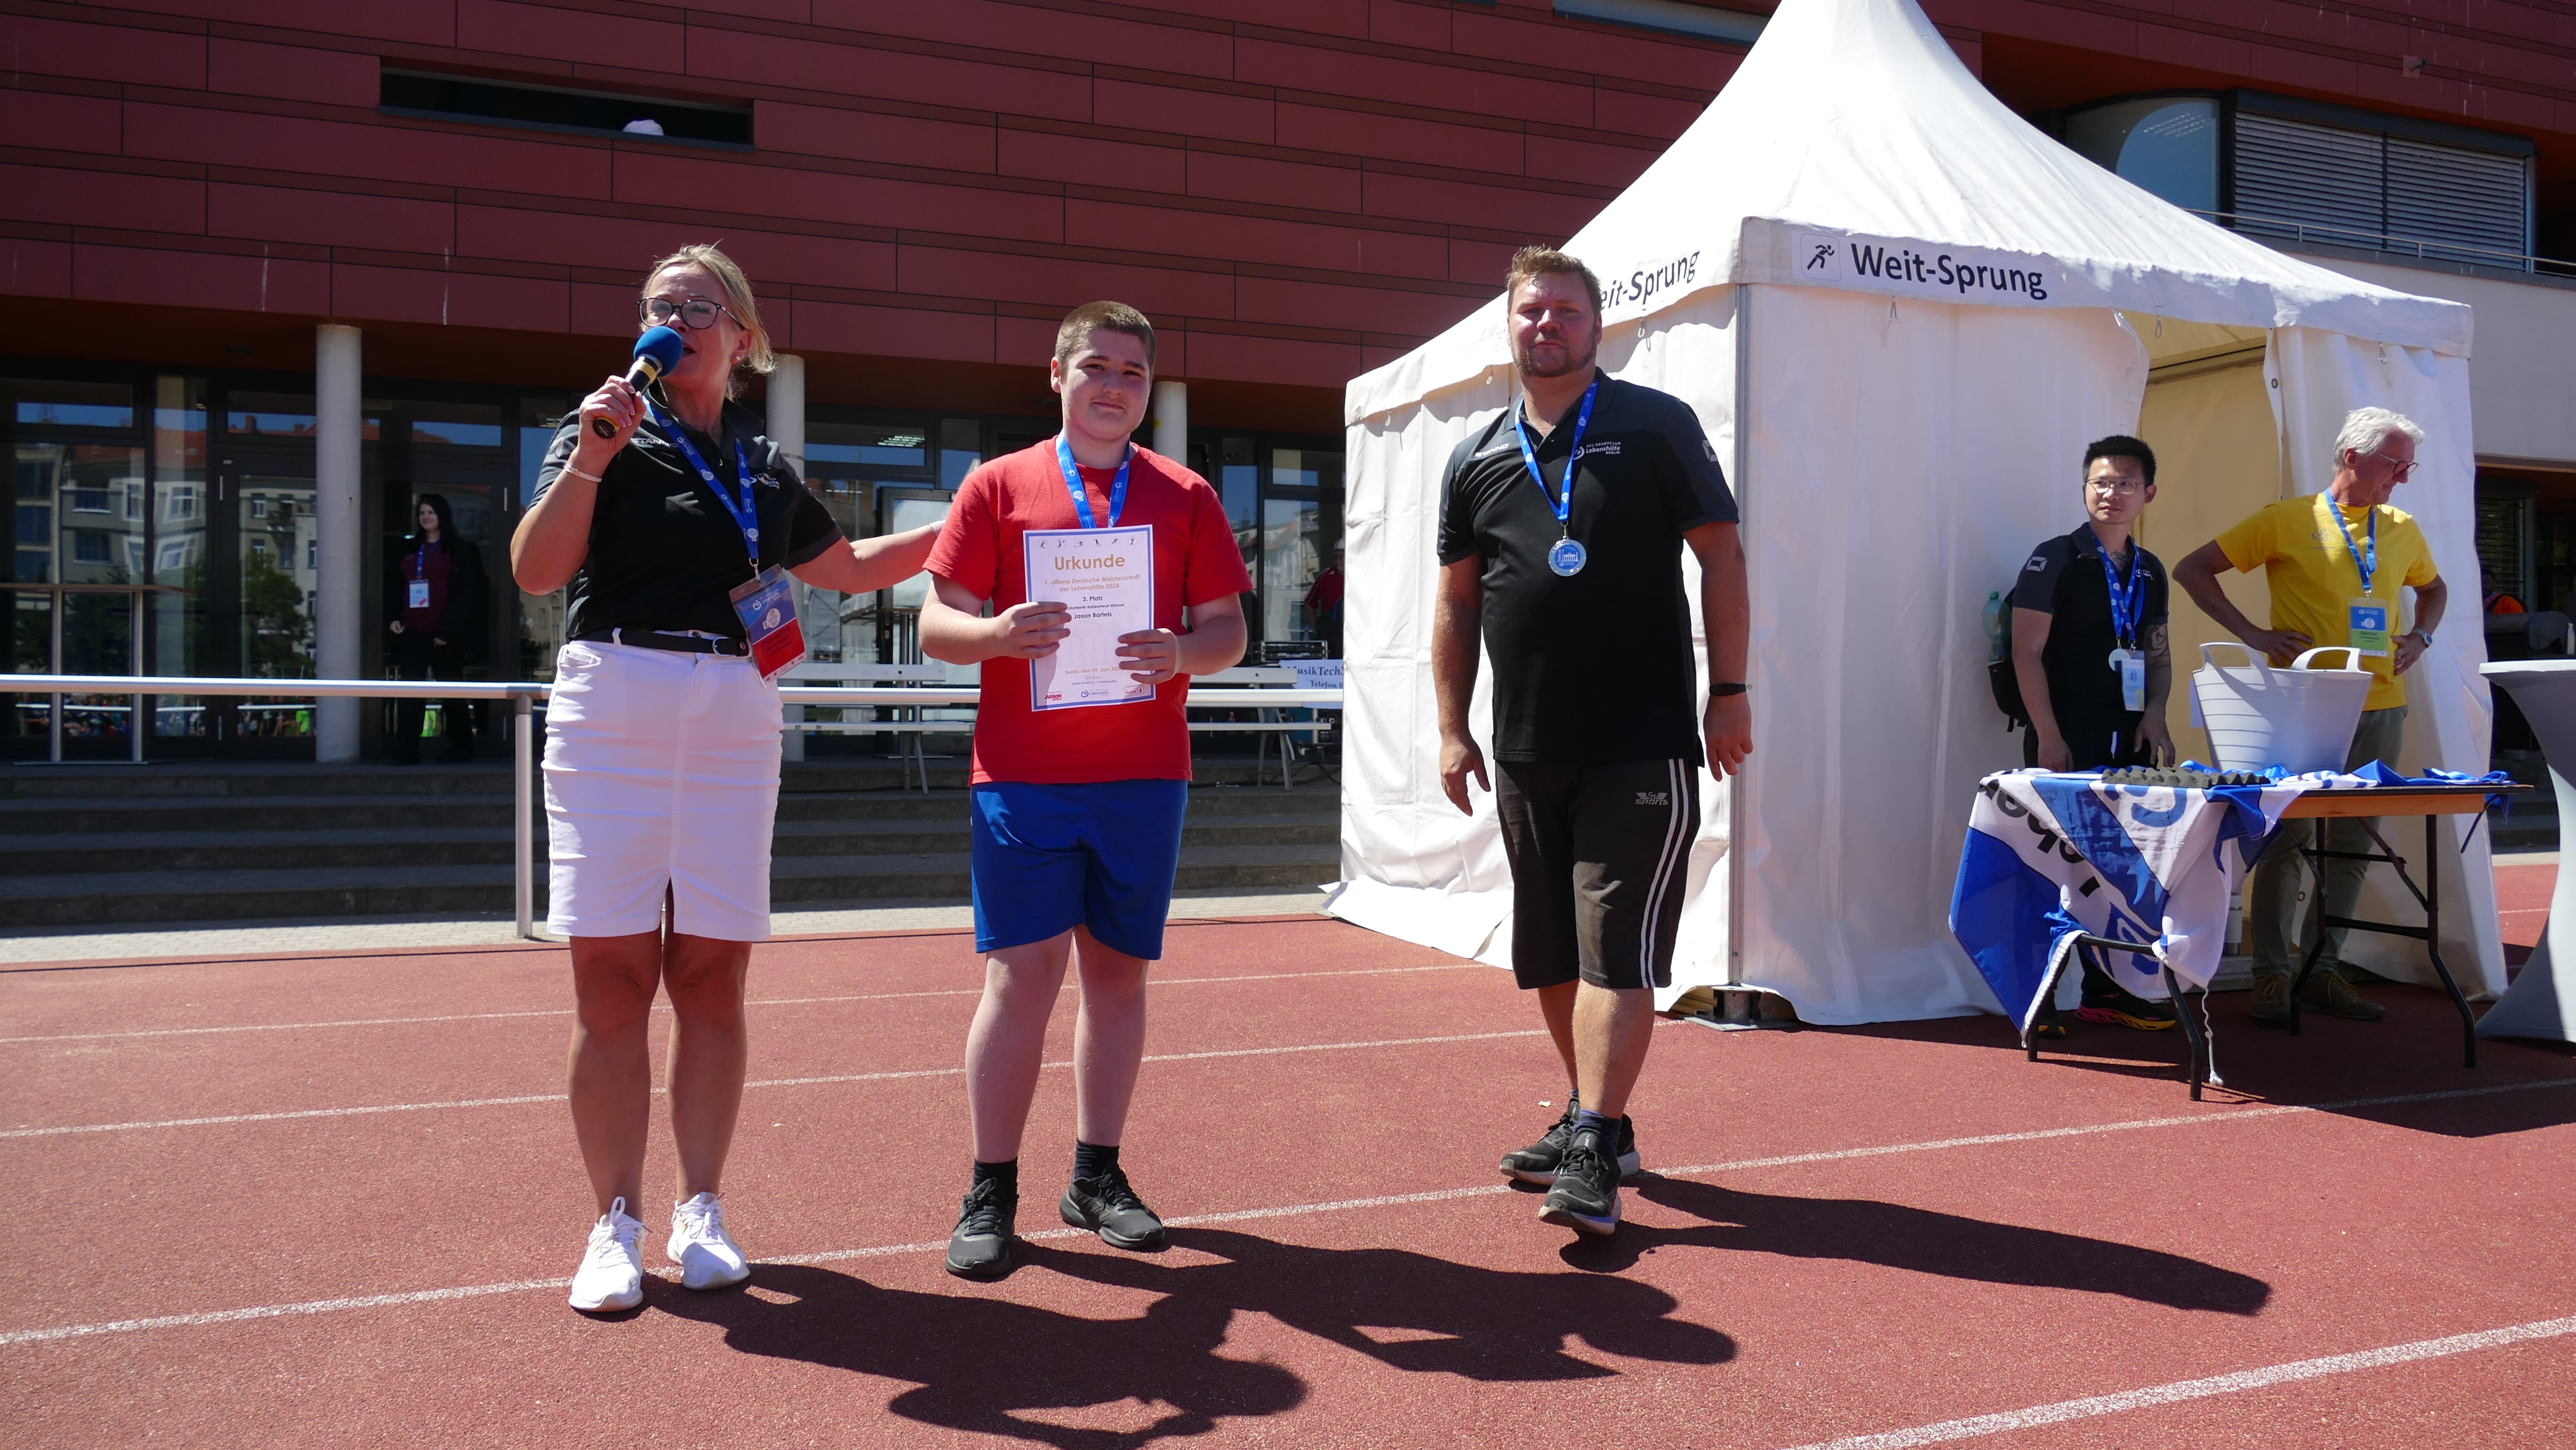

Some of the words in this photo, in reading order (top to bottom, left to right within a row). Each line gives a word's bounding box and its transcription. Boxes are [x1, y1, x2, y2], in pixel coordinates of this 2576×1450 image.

[1851, 243, 2047, 300] Weit-Sprung
[1601, 250, 1700, 310] eit-Sprung
[1586, 445, 1620, 453] Lebenshilfe
[1055, 554, 1126, 571] Urkunde
[1288, 666, 1344, 676] usikTech
[1310, 681, 1337, 689] Telefon
